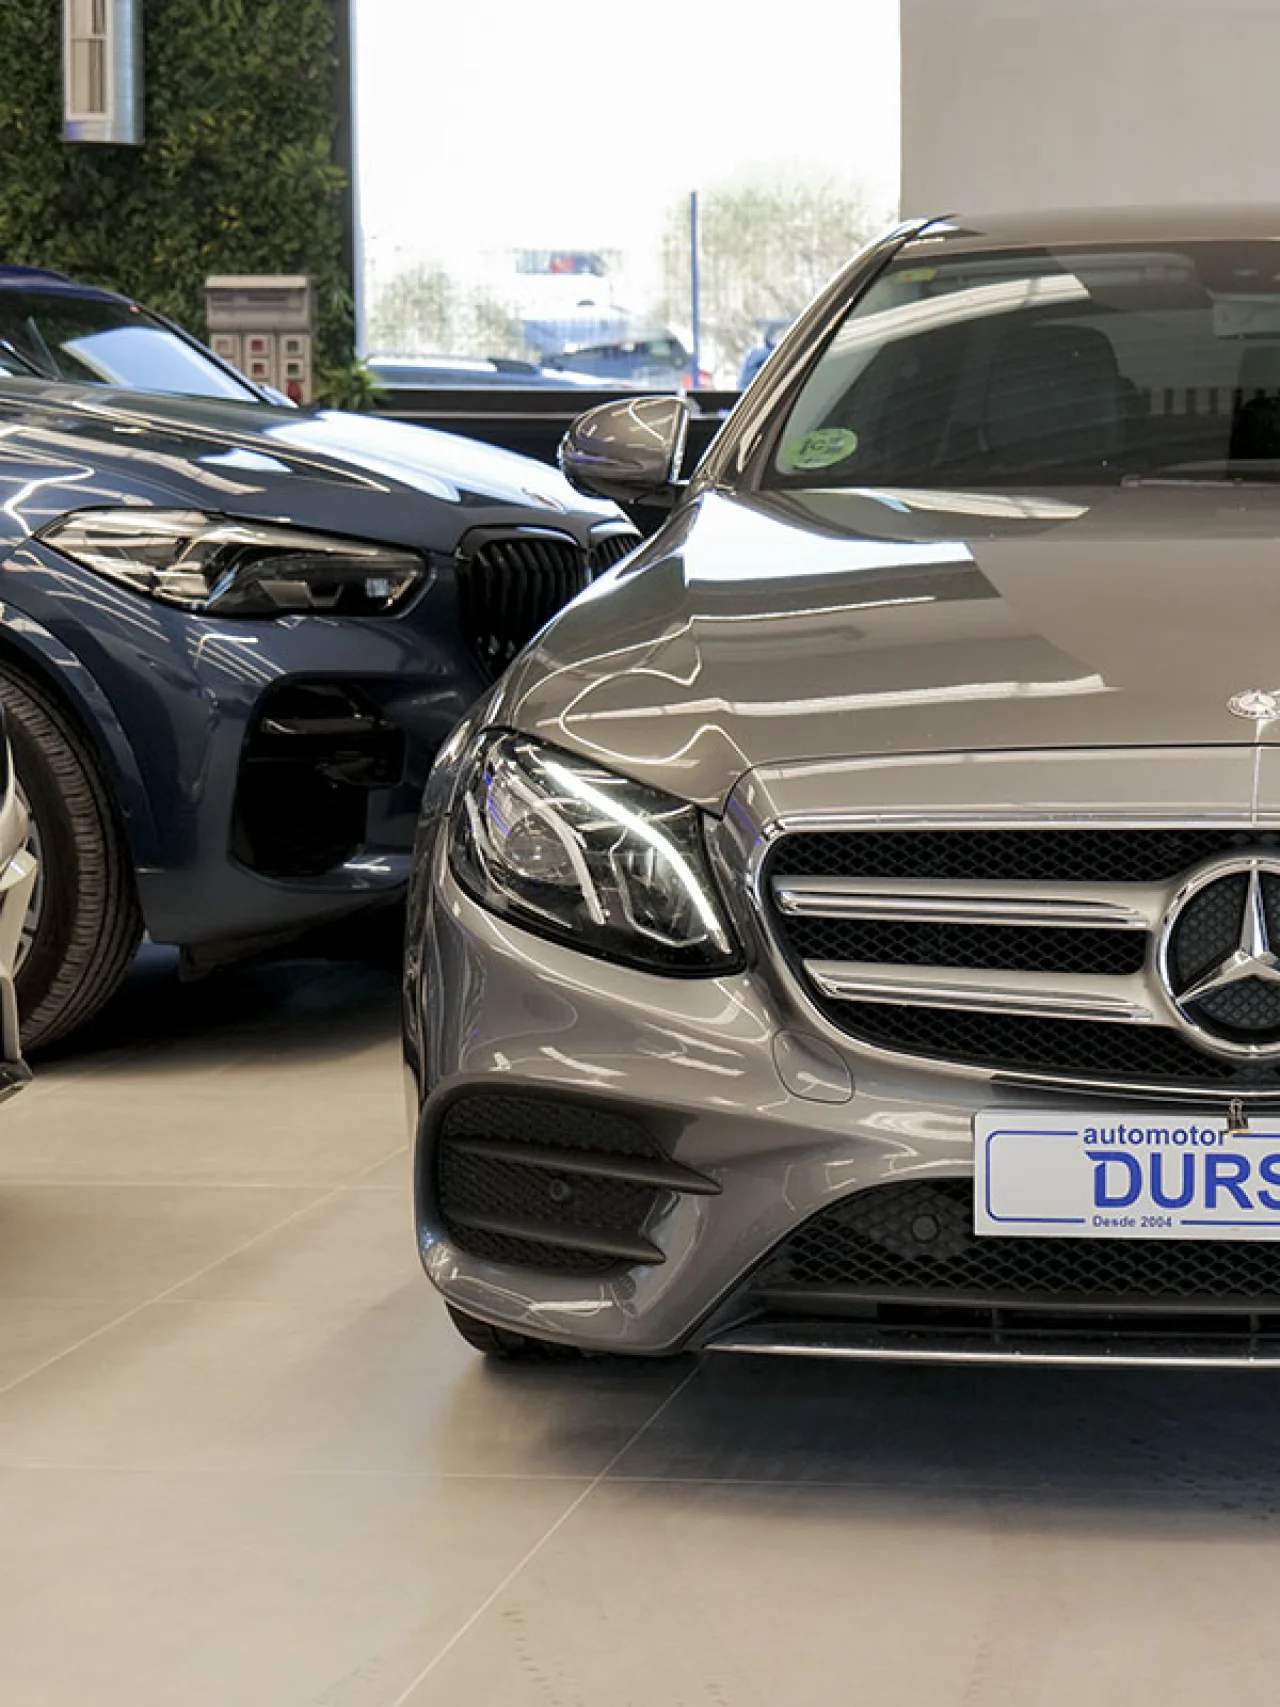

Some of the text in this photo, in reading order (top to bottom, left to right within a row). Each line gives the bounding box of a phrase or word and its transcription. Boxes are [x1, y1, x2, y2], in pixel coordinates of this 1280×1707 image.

[1083, 1123, 1229, 1146] automotor
[1092, 1215, 1172, 1228] Desde 2004
